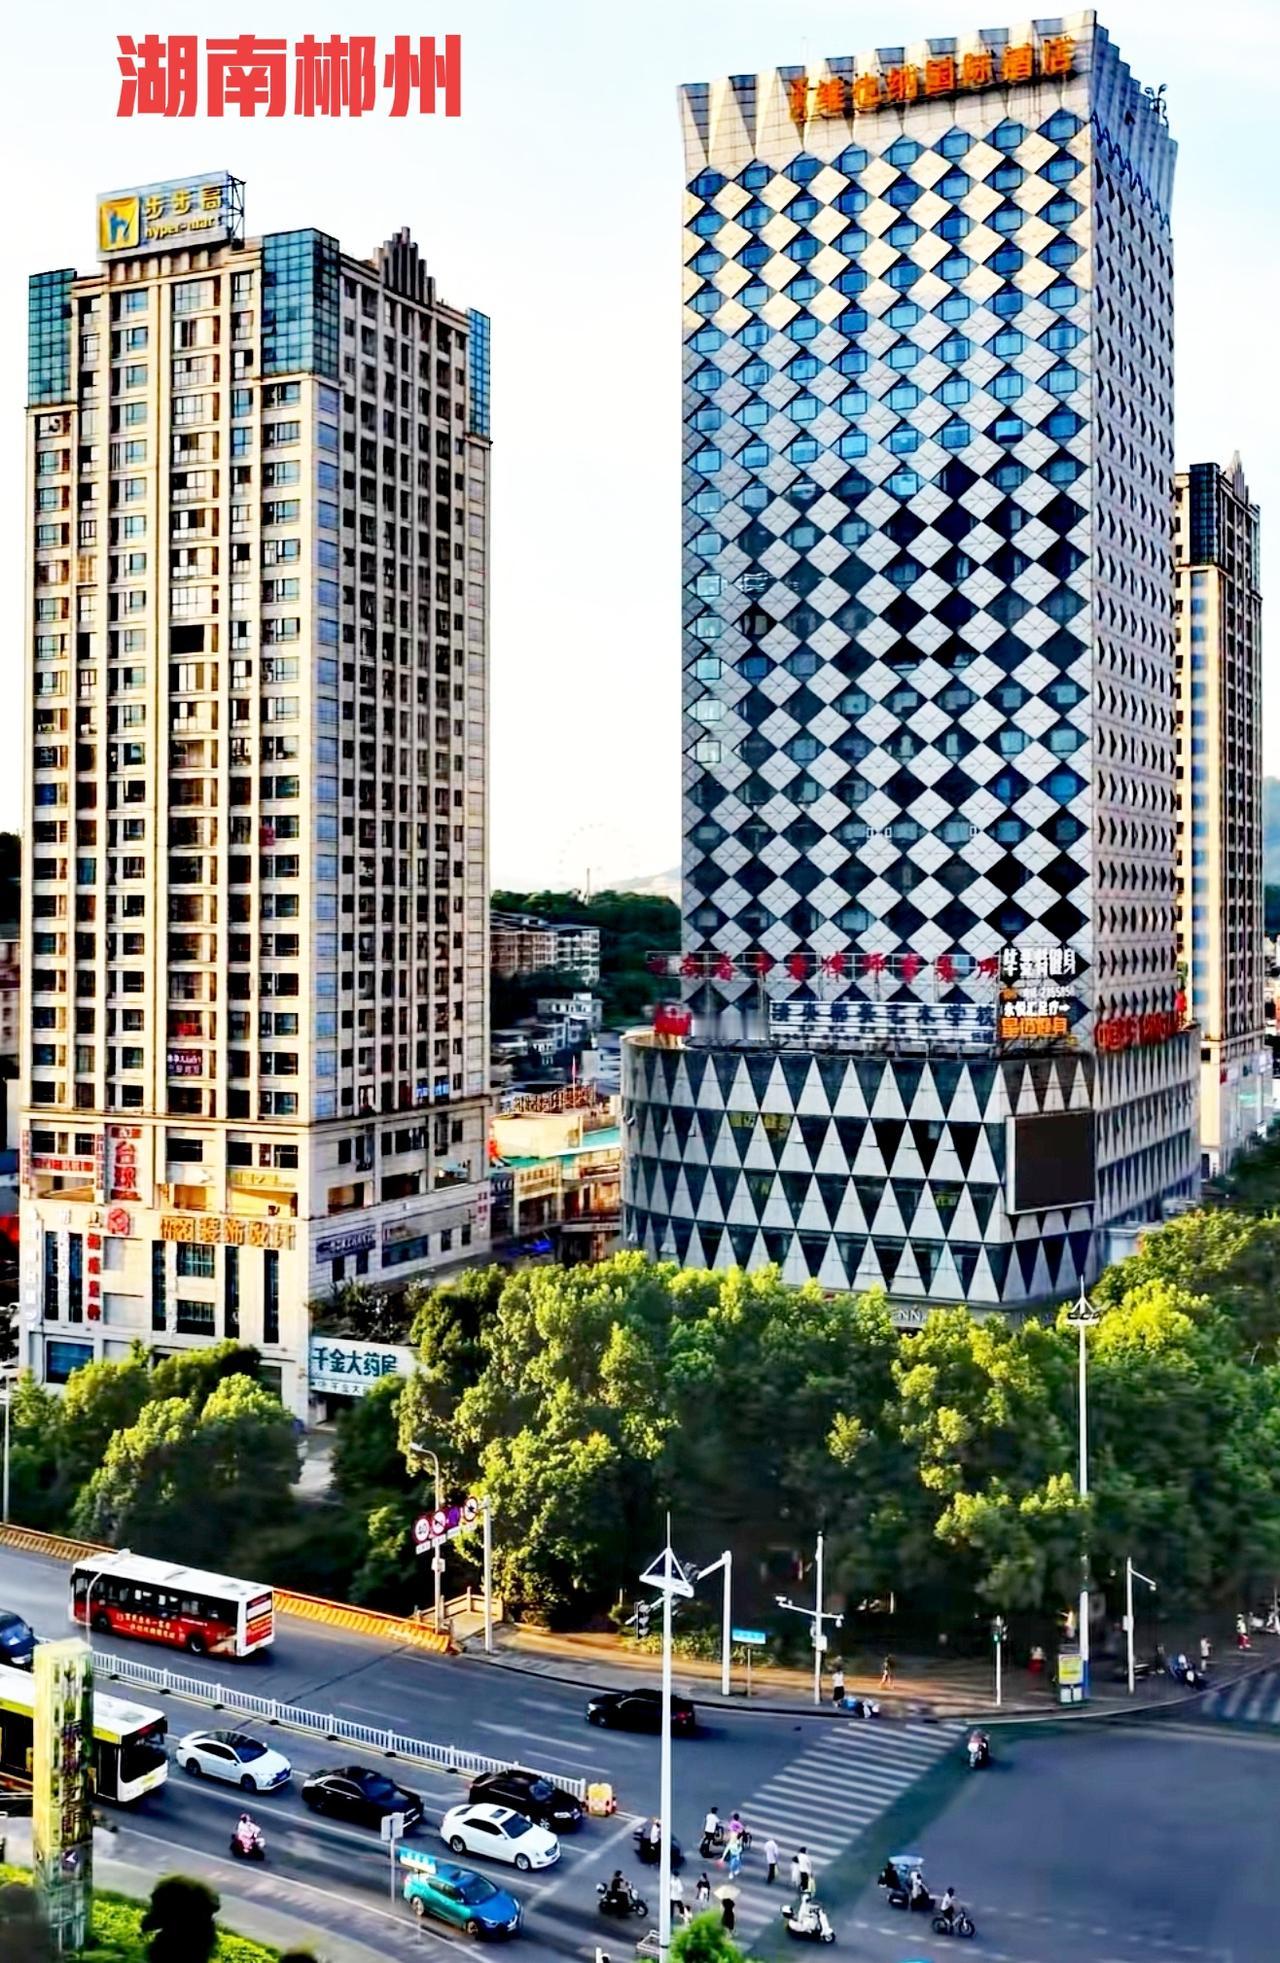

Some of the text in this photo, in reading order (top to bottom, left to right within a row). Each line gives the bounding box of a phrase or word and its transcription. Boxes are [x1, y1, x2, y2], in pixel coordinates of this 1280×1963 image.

[145, 186, 223, 221] 步步高
[311, 1347, 398, 1377] 千金大药房
